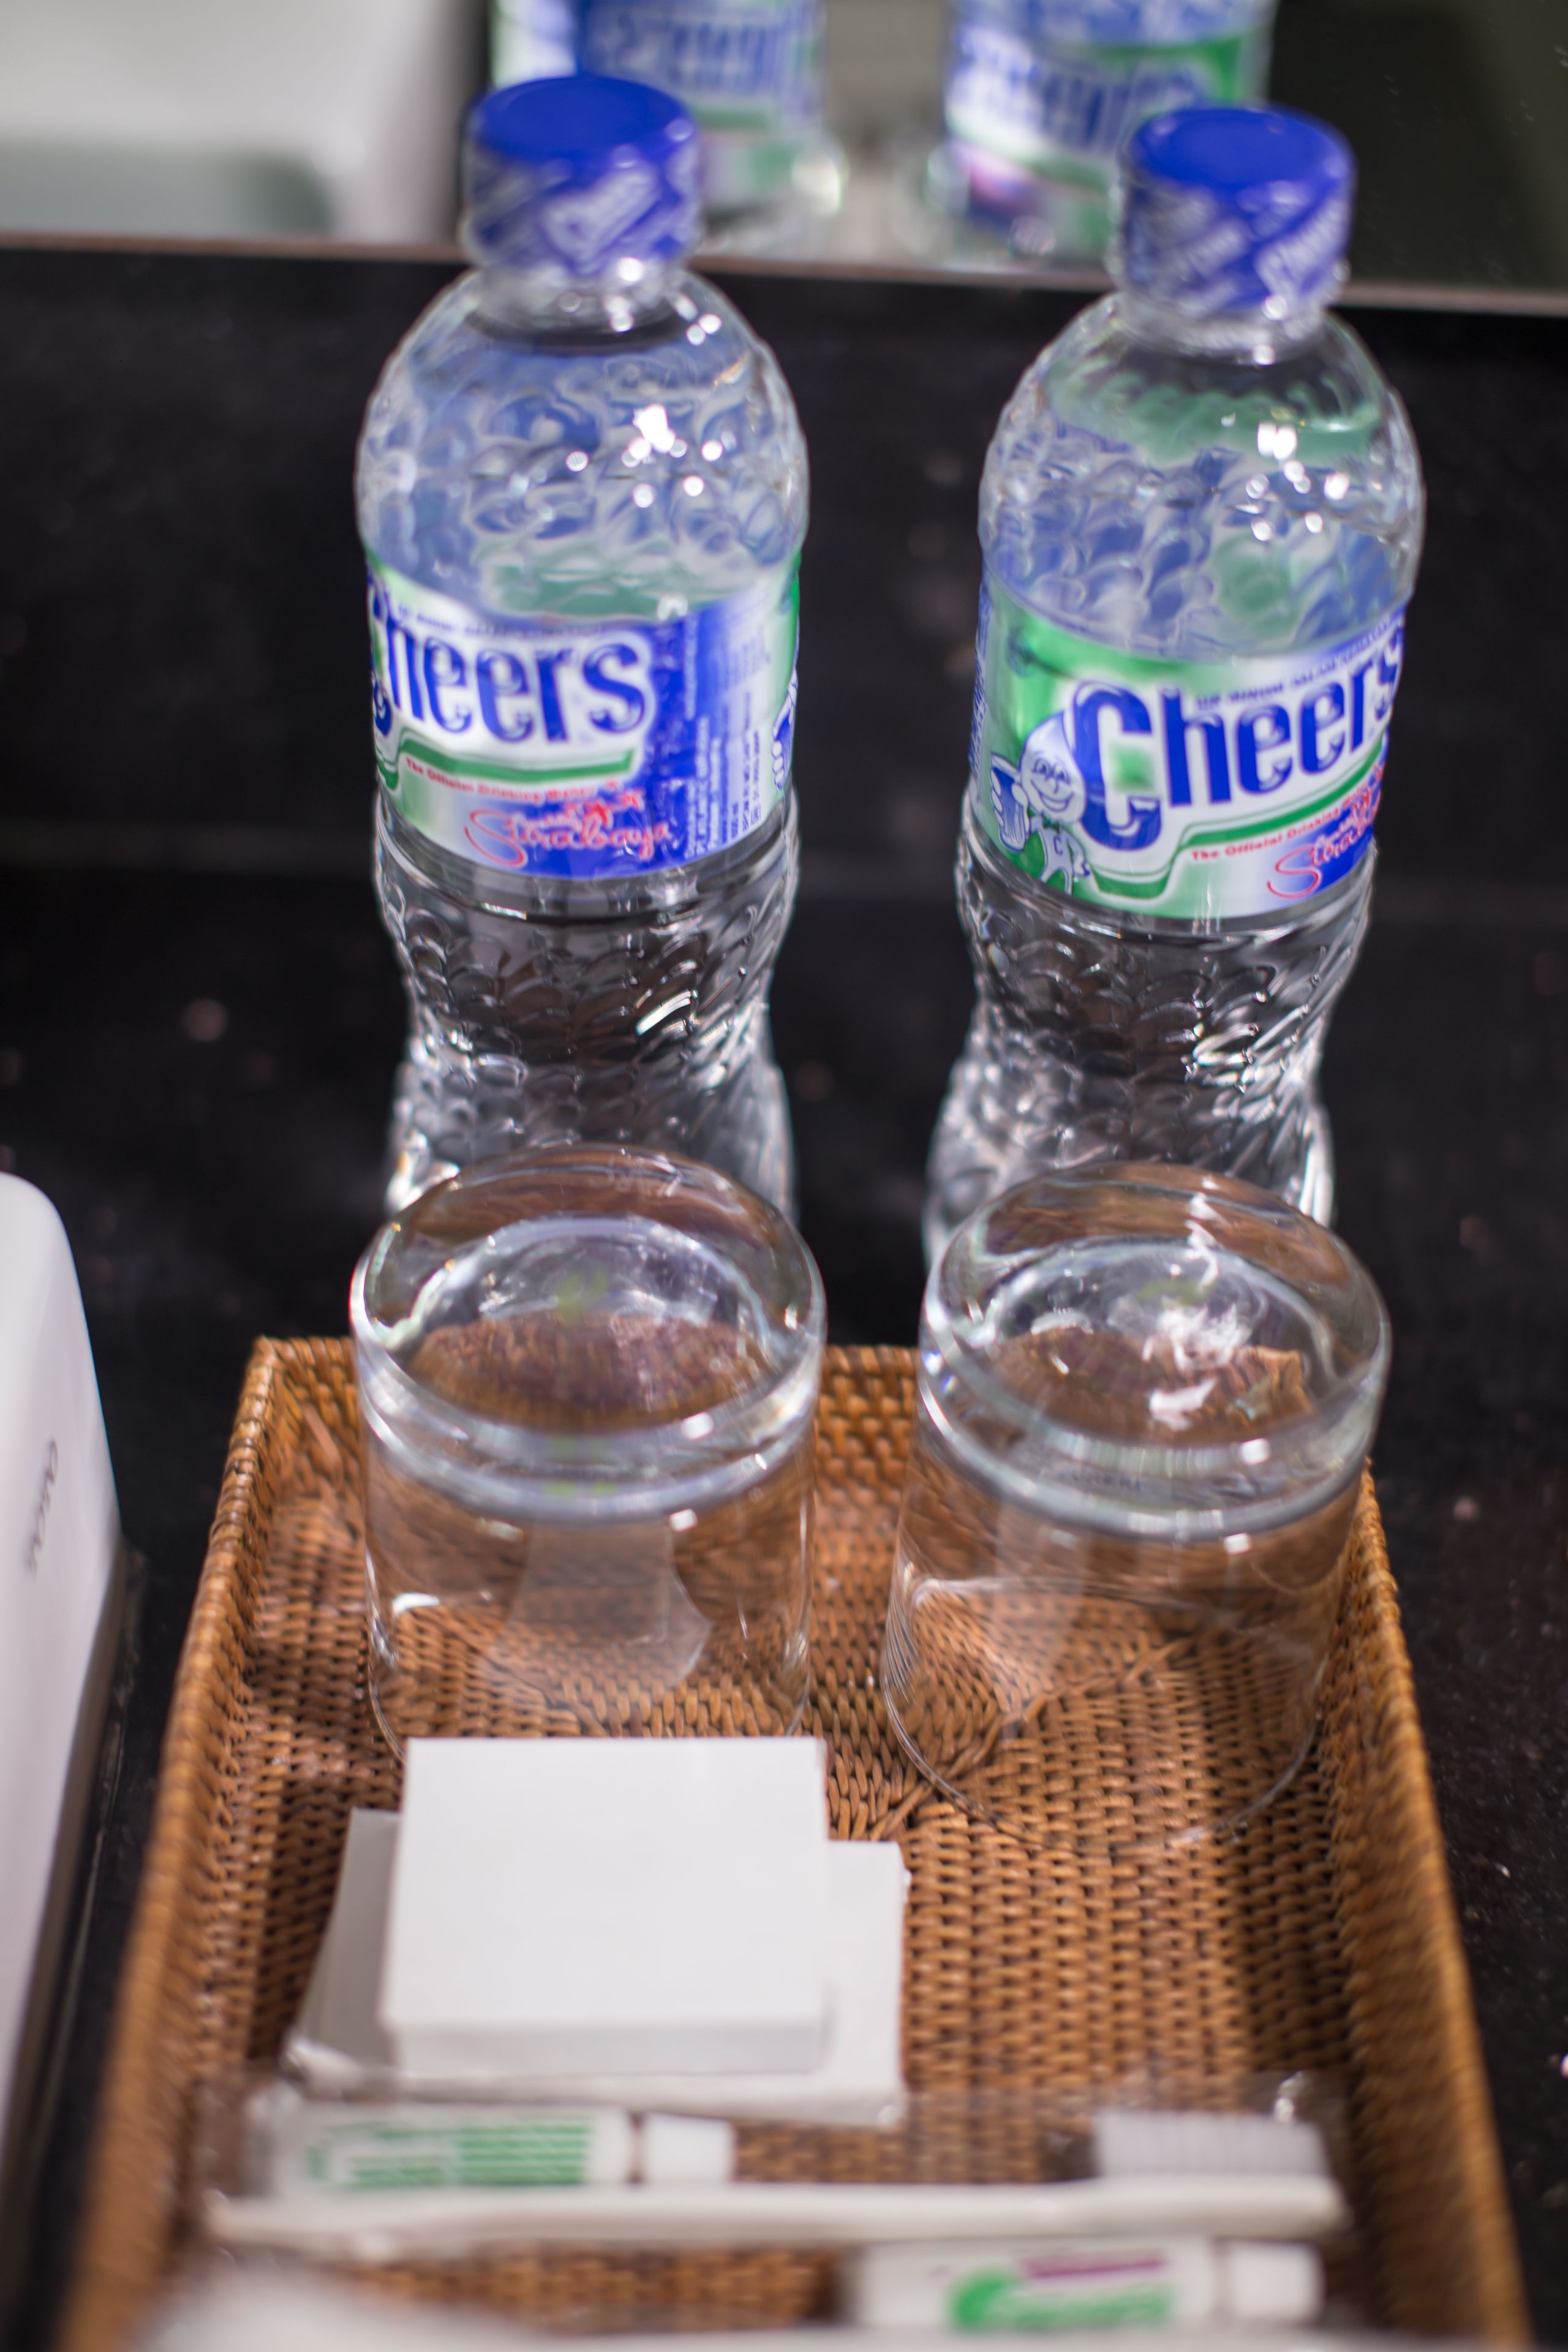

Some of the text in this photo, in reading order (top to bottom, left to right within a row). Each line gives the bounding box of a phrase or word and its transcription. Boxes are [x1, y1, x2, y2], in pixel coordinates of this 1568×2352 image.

[405, 756, 424, 775] The
[426, 767, 475, 793] Official
[1191, 850, 1219, 861] The
[1224, 834, 1282, 856] Official
[1287, 807, 1340, 839] Drinking
